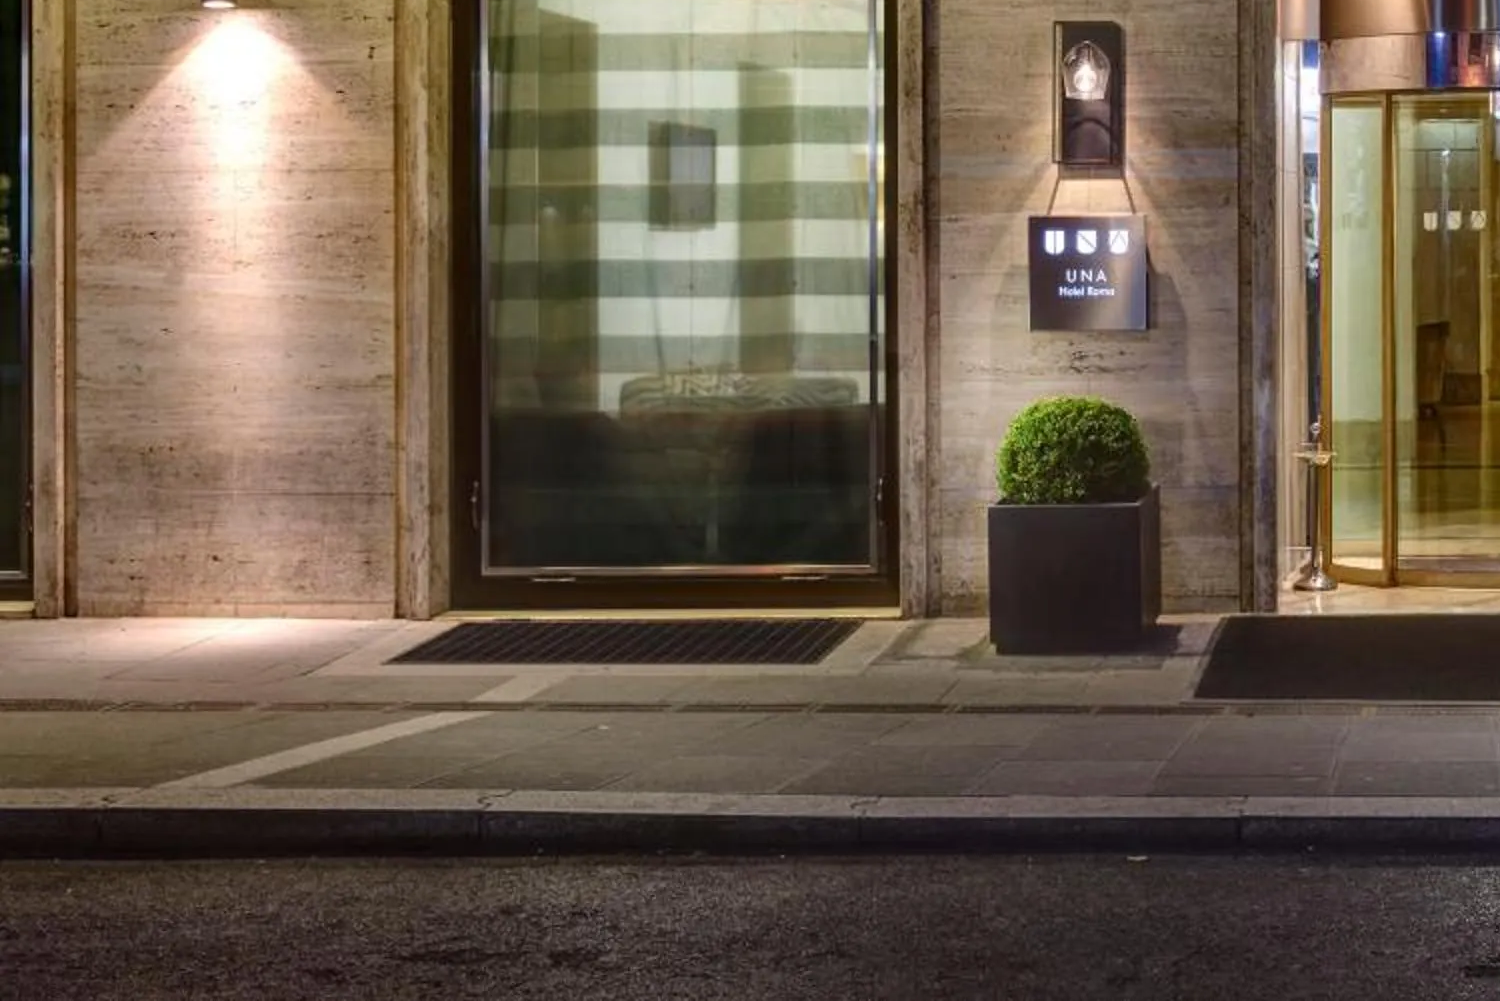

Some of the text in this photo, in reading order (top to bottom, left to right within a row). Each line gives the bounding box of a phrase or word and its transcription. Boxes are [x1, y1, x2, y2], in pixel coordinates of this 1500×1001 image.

[1065, 268, 1107, 283] UNA
[1058, 286, 1115, 296] Hotel Roma
